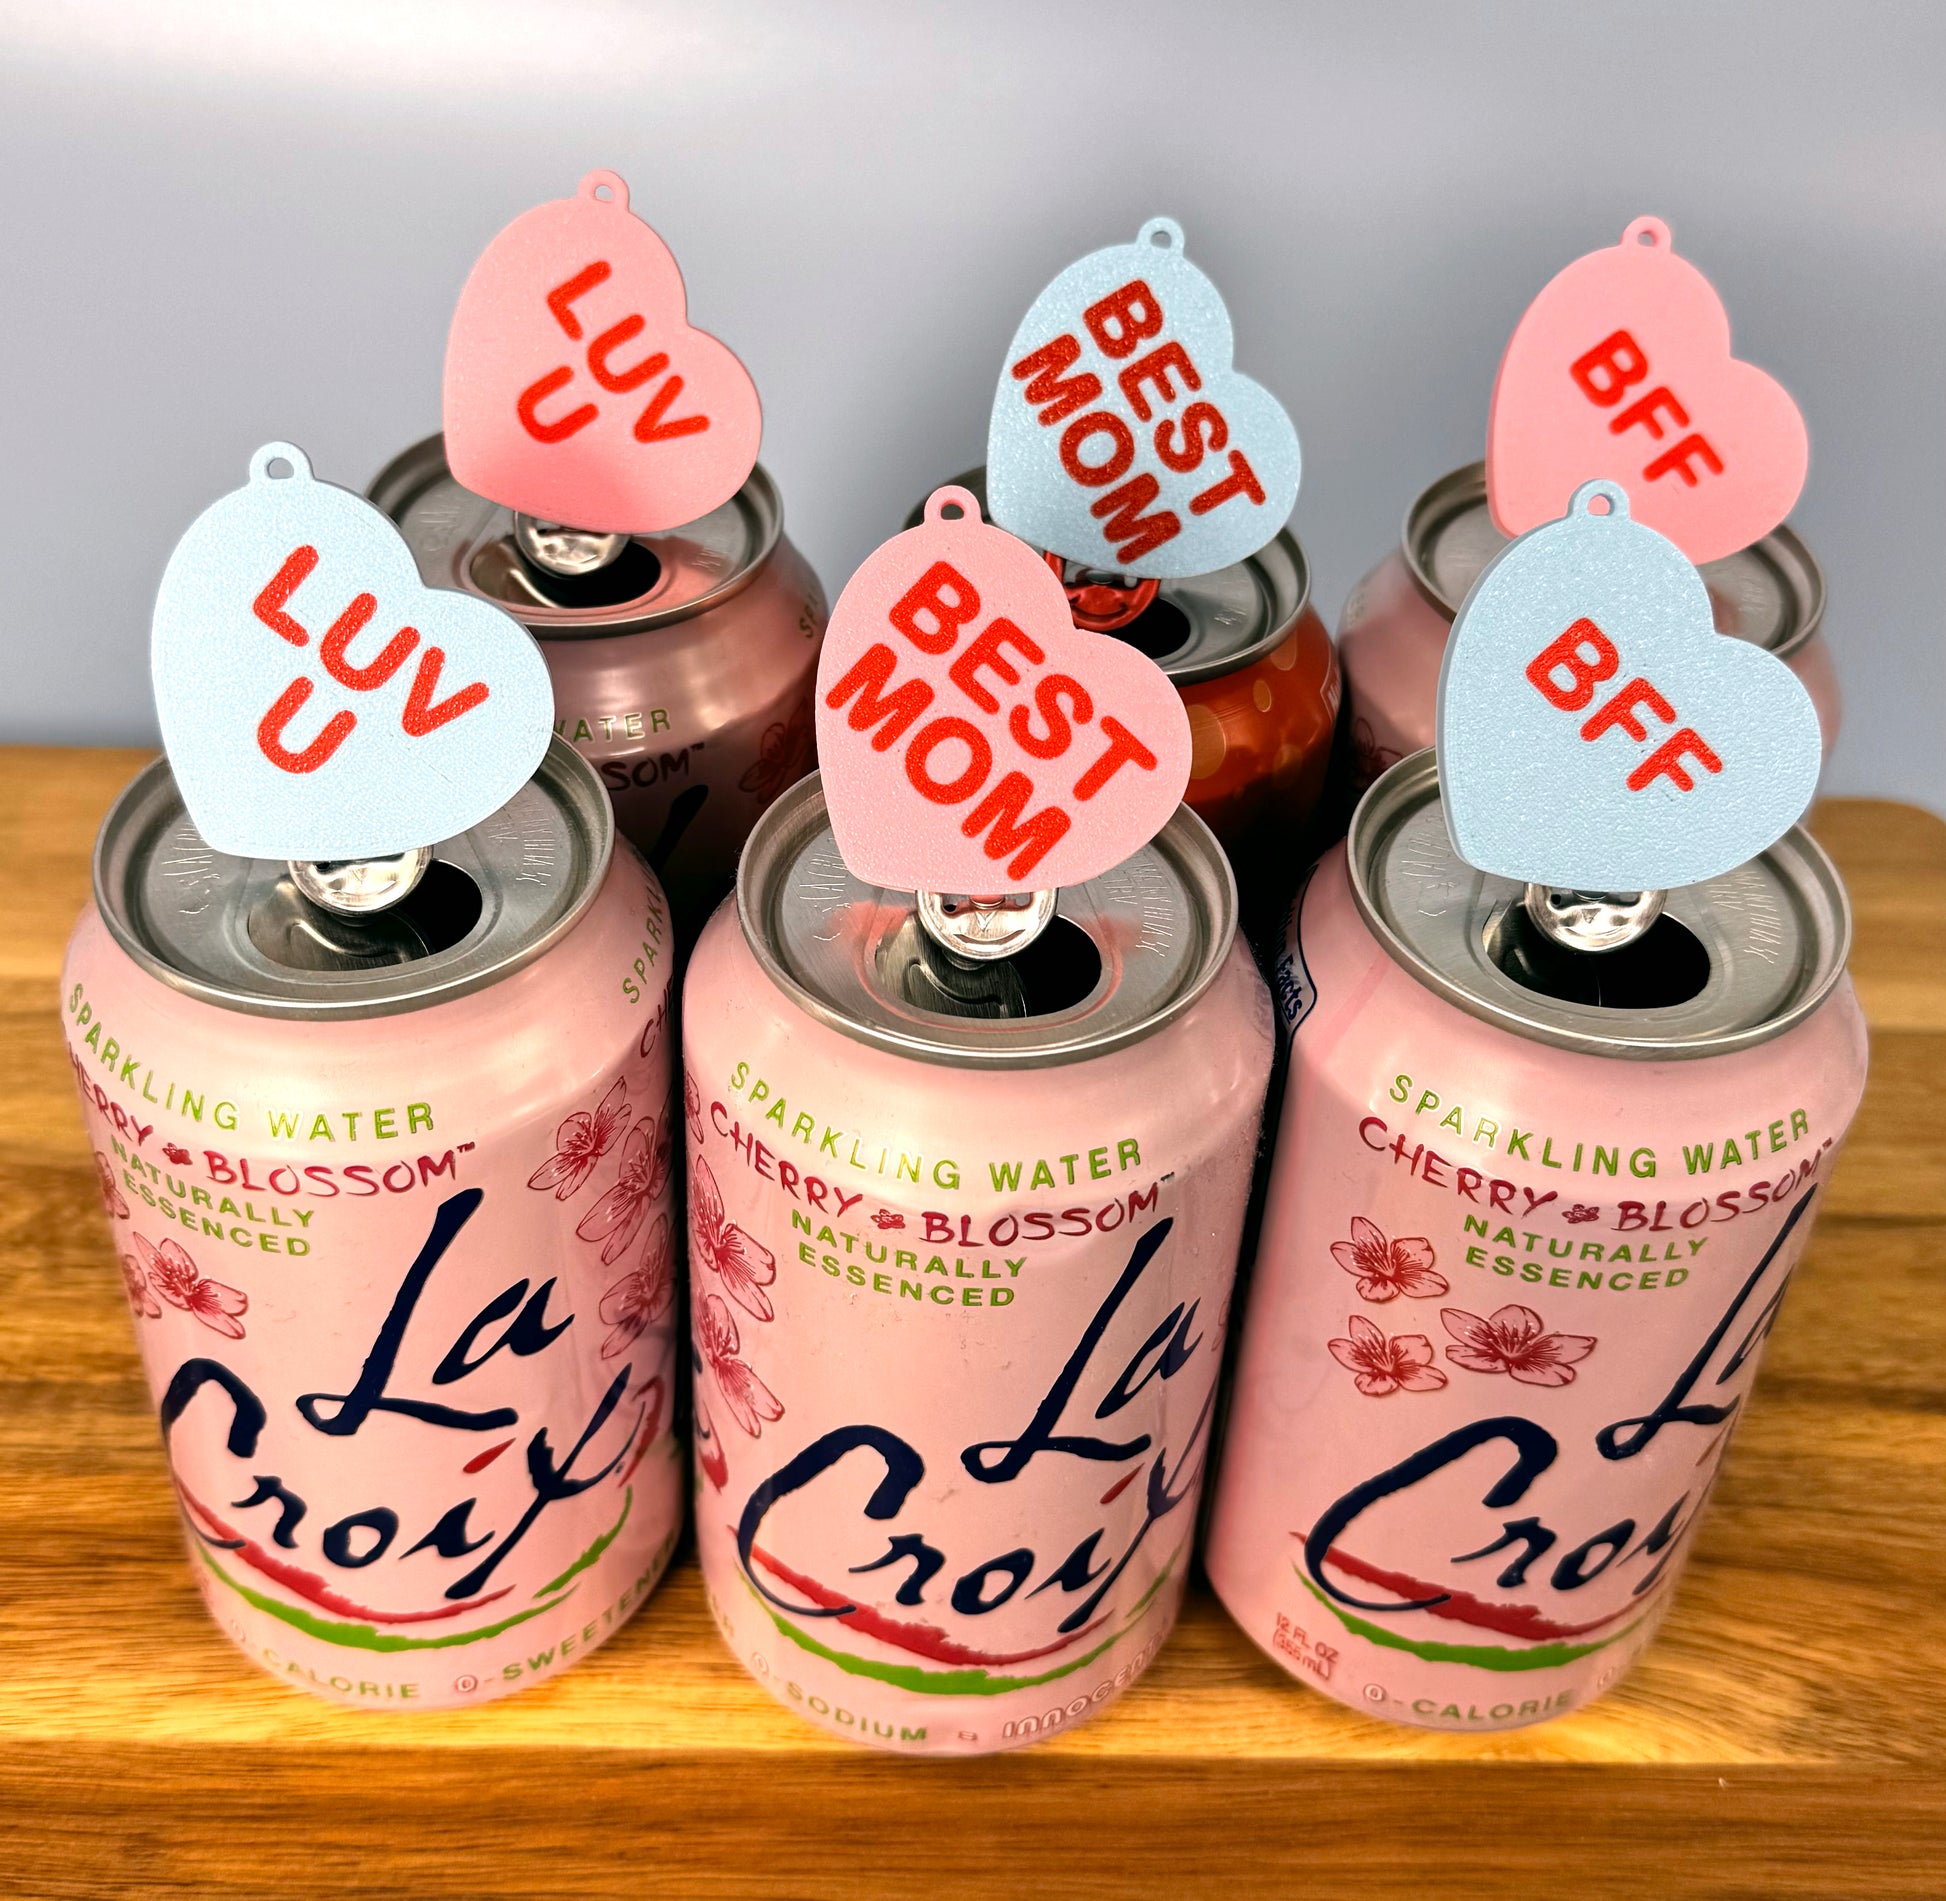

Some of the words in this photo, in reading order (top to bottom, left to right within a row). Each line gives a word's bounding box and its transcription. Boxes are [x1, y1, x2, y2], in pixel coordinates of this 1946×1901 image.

[516, 364, 600, 445] U
[546, 259, 710, 444] LUV
[1082, 278, 1266, 516] BEST
[1570, 328, 1725, 489] BFF
[1010, 334, 1182, 565] MOM
[251, 543, 490, 738] LUV
[889, 560, 1158, 802] BEST
[1525, 616, 1724, 794] BFF
[256, 675, 358, 775] U
[825, 642, 1072, 882] MOM
[69, 982, 238, 1131] SPARKLING
[268, 1101, 434, 1142] WATER
[731, 1062, 960, 1191] SPARKLING
[988, 1137, 1142, 1193] WATER
[1389, 1074, 1656, 1178] SPARKLING
[1682, 1107, 1809, 1175] WATER
[111, 1134, 315, 1228] NATURALLY
[123, 1168, 311, 1257] ESSENCED
[710, 1100, 863, 1218] CHERRY
[1358, 1115, 1559, 1218] CHERRY
[791, 1208, 1028, 1280] NATURALLY
[798, 1241, 1016, 1308] ESSENCED
[1463, 1214, 1709, 1265] NATURALLY
[1464, 1245, 1689, 1291] ESSENCED
[296, 1187, 575, 1436] La
[960, 1216, 1204, 1484] La
